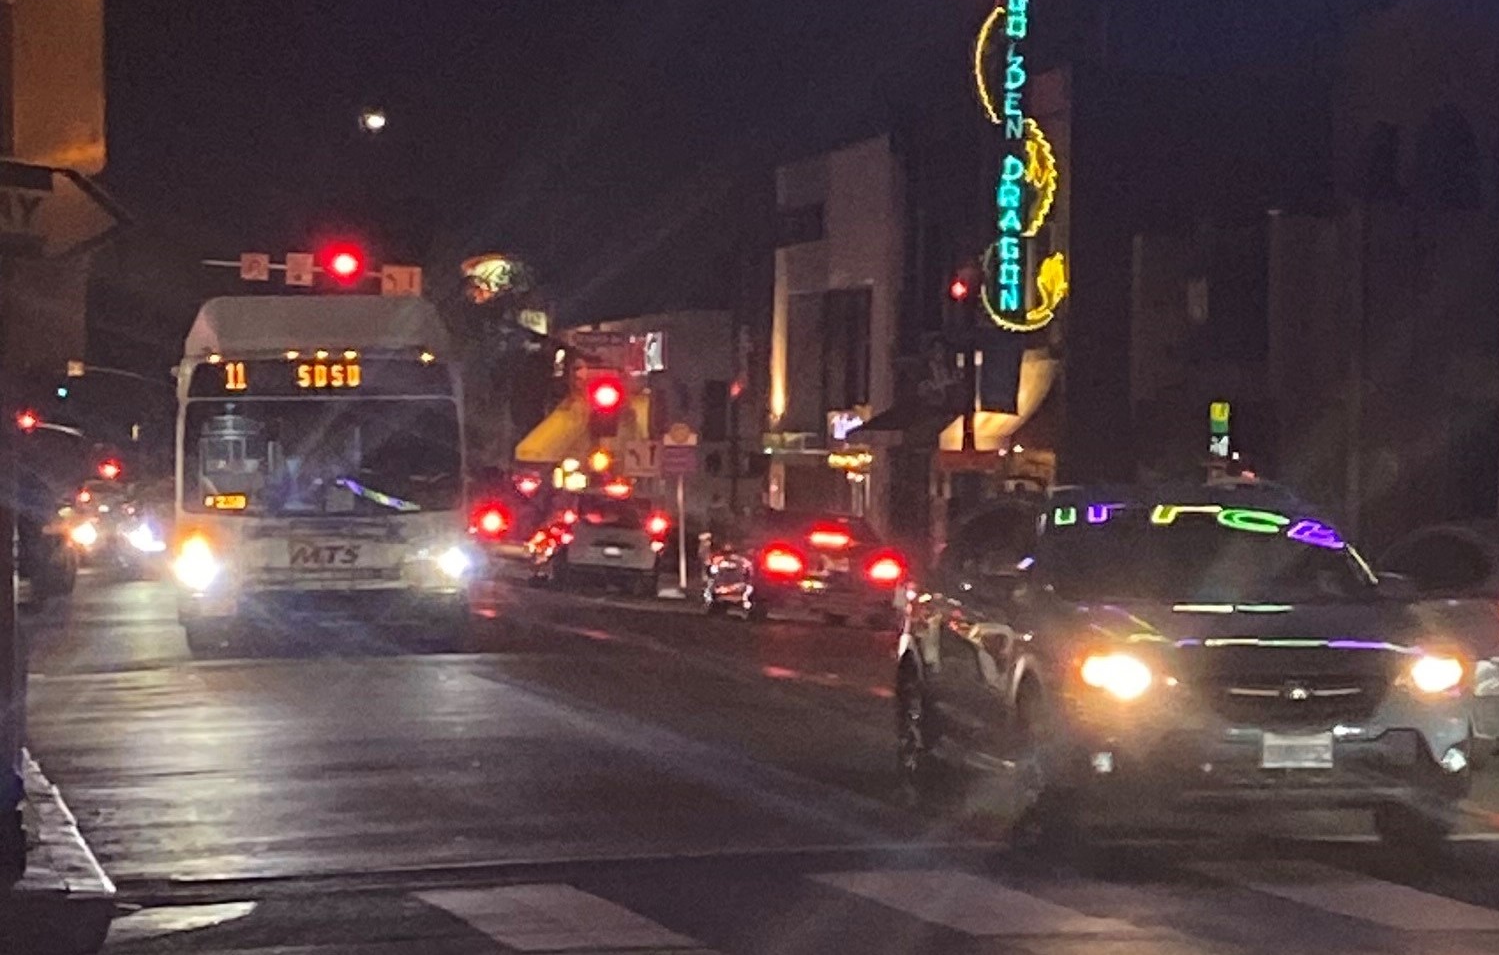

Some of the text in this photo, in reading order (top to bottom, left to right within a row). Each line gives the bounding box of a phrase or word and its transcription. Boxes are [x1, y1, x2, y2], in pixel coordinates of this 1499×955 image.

[998, 155, 1025, 311] DRAGON
[225, 362, 247, 389] 11
[290, 544, 361, 564] MTS
